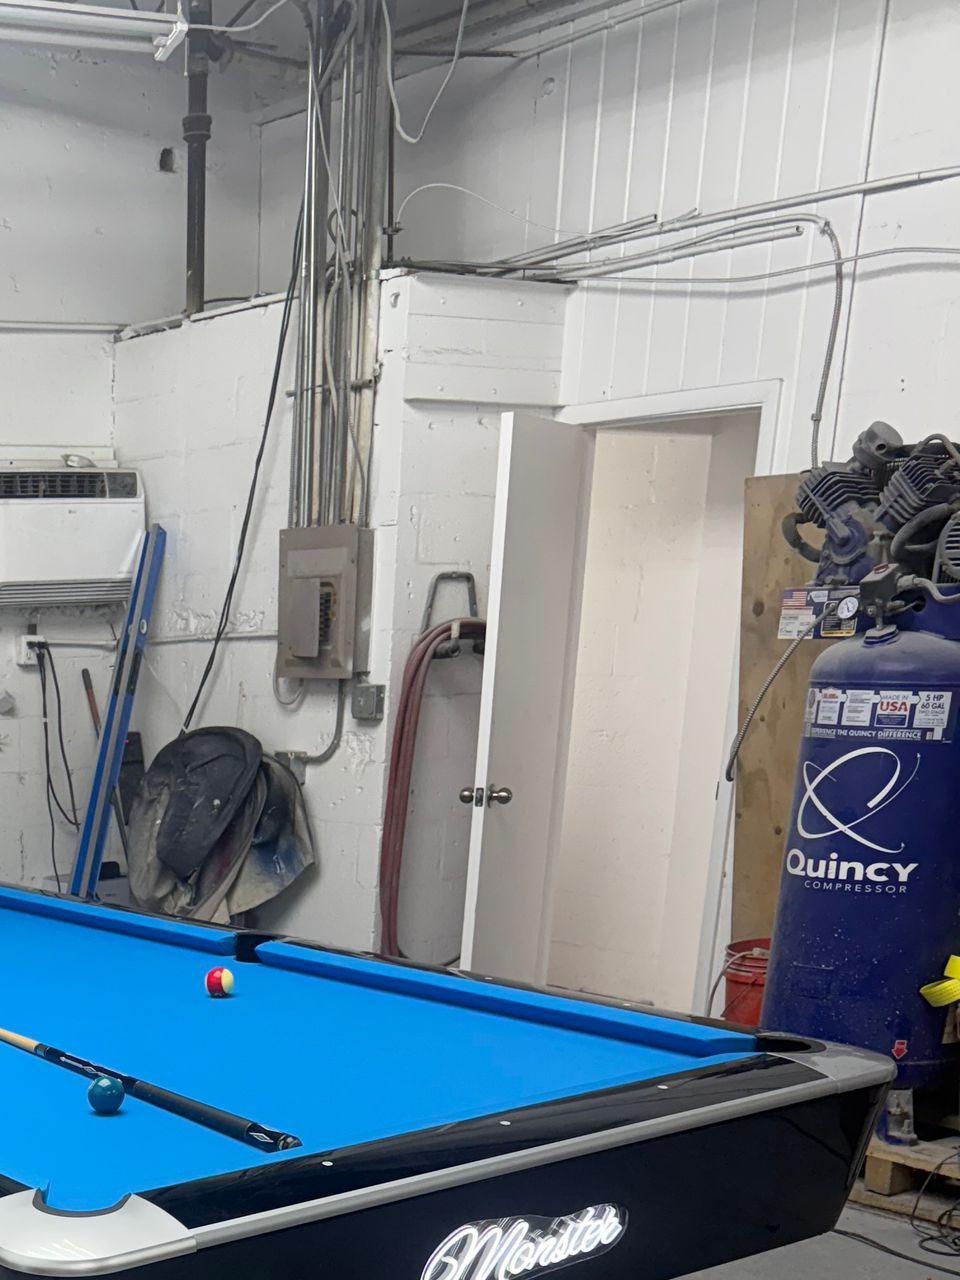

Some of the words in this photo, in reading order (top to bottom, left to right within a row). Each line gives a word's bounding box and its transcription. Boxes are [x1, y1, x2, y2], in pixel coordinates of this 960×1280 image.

[880, 701, 908, 712] USA
[838, 728, 848, 736] THE
[878, 730, 921, 739] DIFFERENCE
[804, 880, 907, 893] COMPRESSOR
